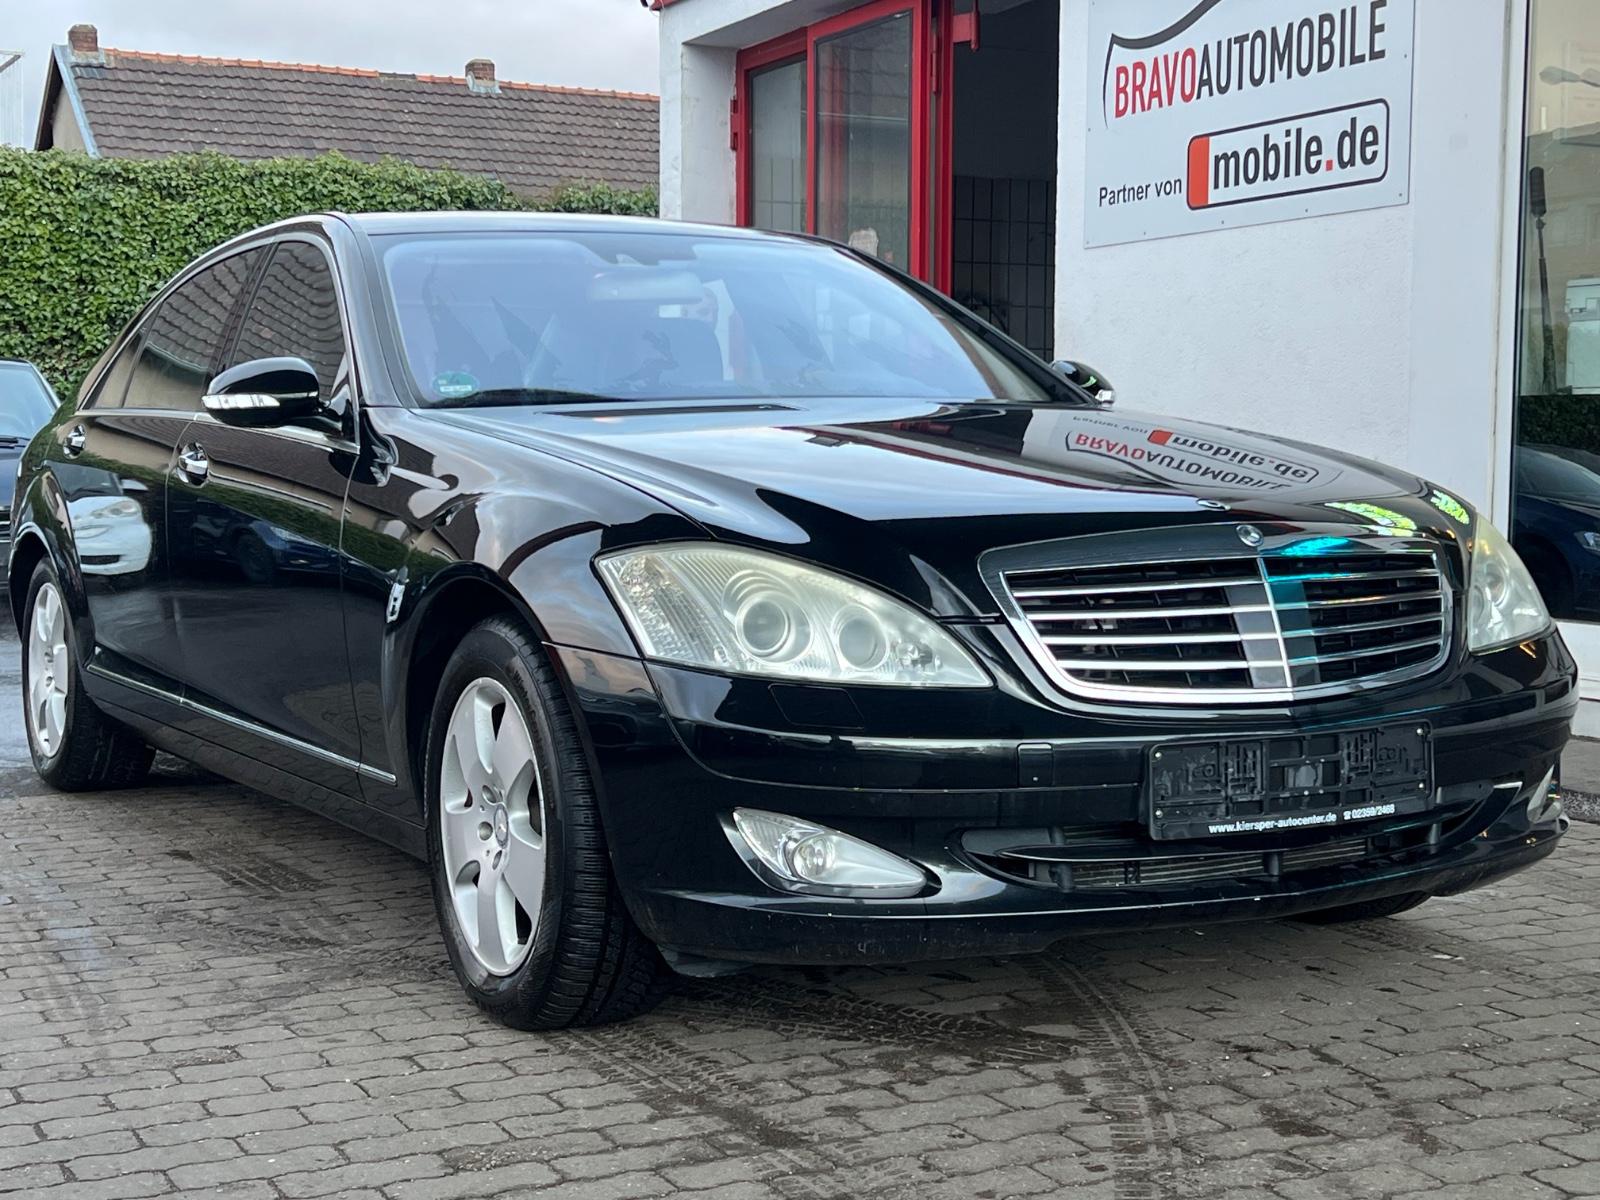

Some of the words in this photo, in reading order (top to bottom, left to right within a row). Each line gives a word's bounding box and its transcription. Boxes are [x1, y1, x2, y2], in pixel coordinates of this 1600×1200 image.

[1099, 182, 1151, 207] Partner
[1154, 178, 1182, 197] von
[1213, 117, 1379, 190] mobile.de
[1208, 811, 1337, 834] www.kiersper-autocenter.de
